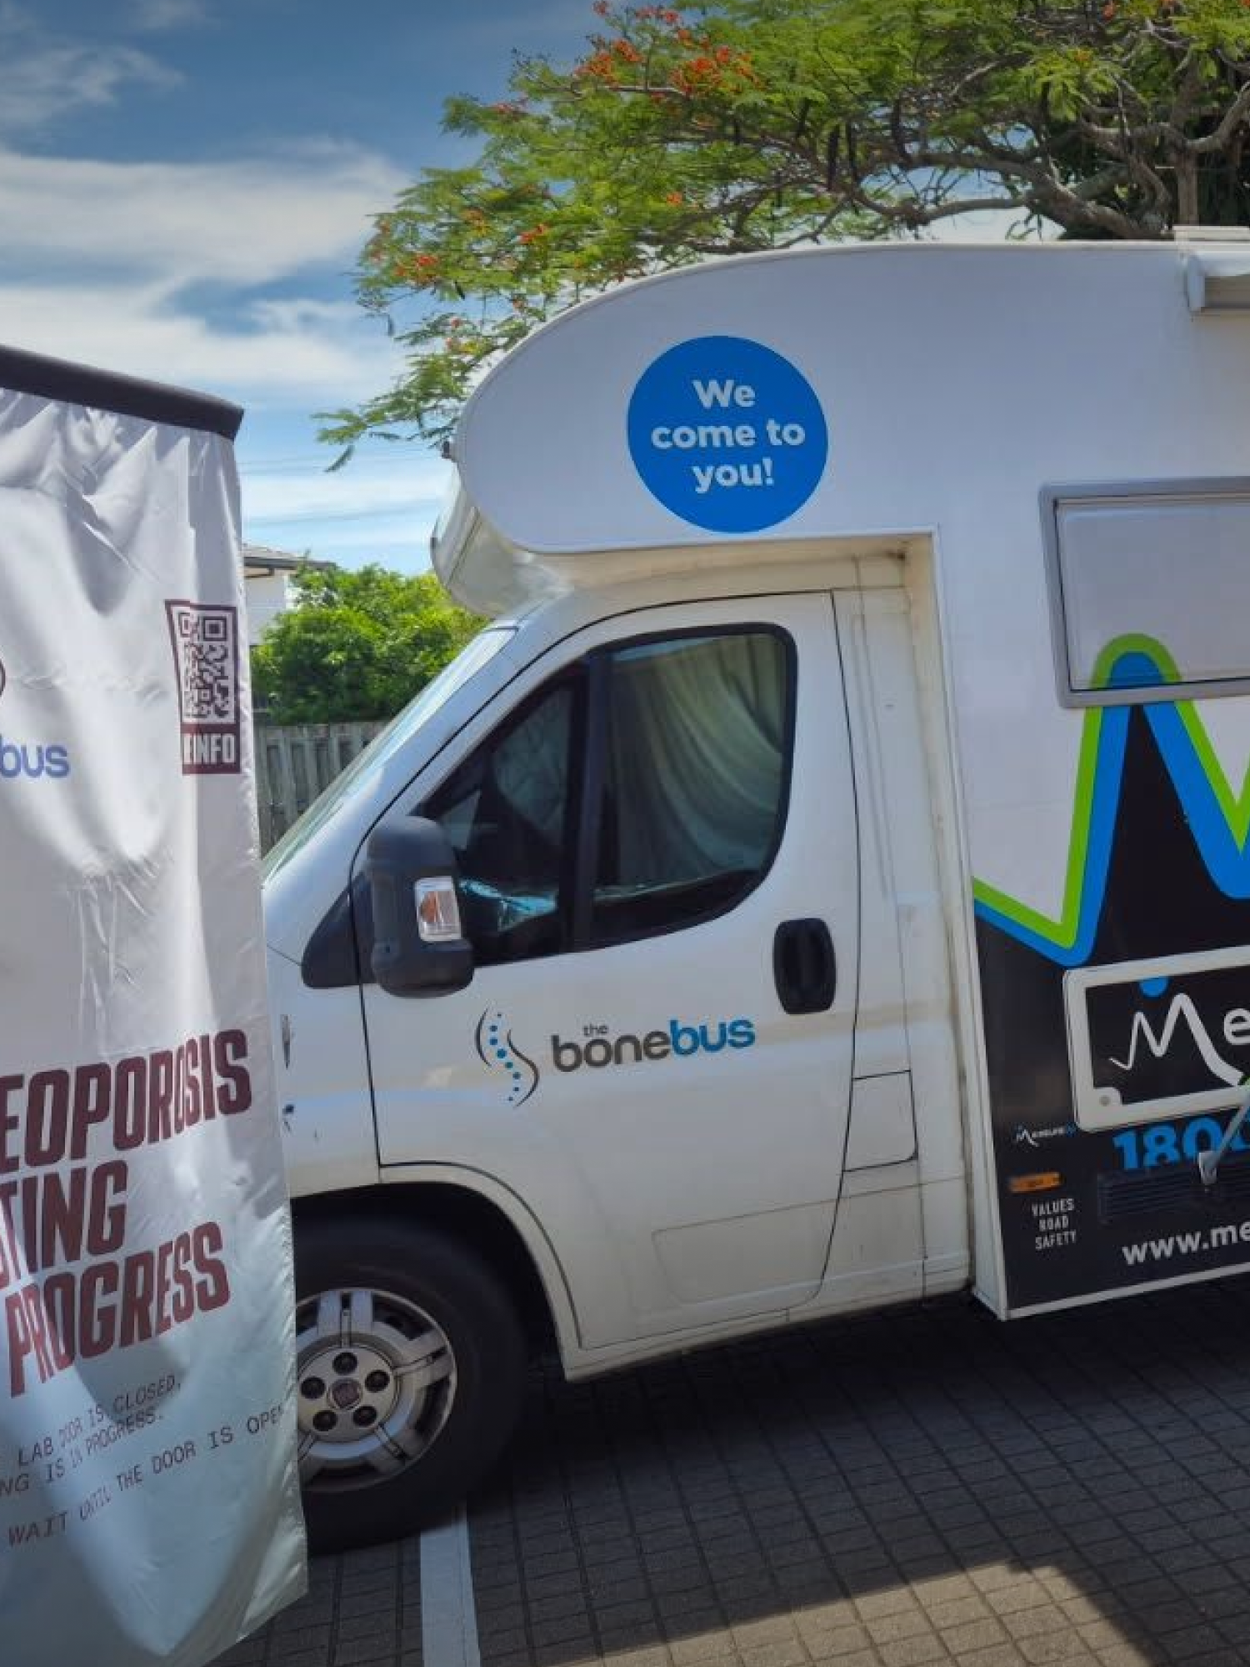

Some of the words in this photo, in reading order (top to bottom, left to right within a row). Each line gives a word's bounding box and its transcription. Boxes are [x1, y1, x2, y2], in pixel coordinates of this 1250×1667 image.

[692, 379, 755, 409] We
[651, 424, 756, 449] come
[766, 418, 806, 446] to
[692, 457, 774, 494] you!
[183, 733, 235, 765] INFO
[583, 1023, 608, 1037] the
[551, 1019, 756, 1072] bonebus
[1031, 1198, 1075, 1216] VALUES
[1039, 1215, 1069, 1231] ROAD
[1035, 1230, 1076, 1250] SAFETY
[5, 1222, 230, 1398] PROGRESS
[18, 1437, 53, 1467] LAB
[46, 1458, 65, 1483] IS
[8, 1511, 67, 1546] WAIT
[117, 1465, 143, 1492] THE
[152, 1440, 196, 1474] DOOR
[208, 1426, 233, 1449] IS
